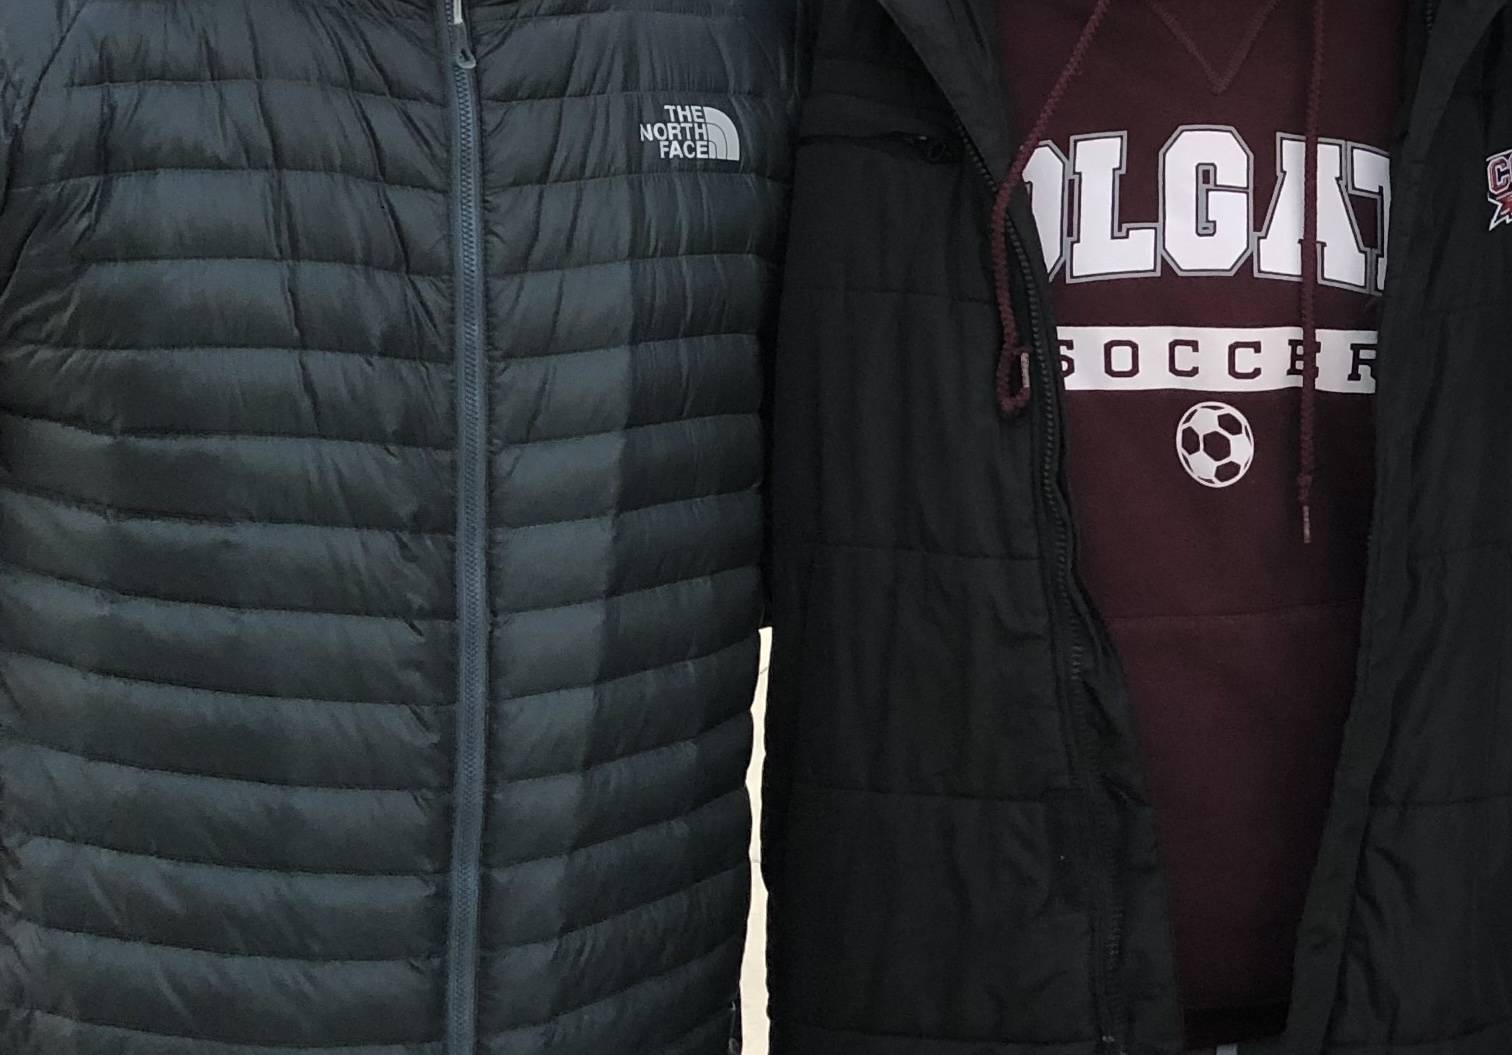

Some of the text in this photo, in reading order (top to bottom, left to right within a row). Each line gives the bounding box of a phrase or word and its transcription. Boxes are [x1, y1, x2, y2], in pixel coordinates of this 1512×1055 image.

[663, 104, 706, 123] THE
[639, 122, 708, 142] NORTH
[659, 140, 710, 159] FACE
